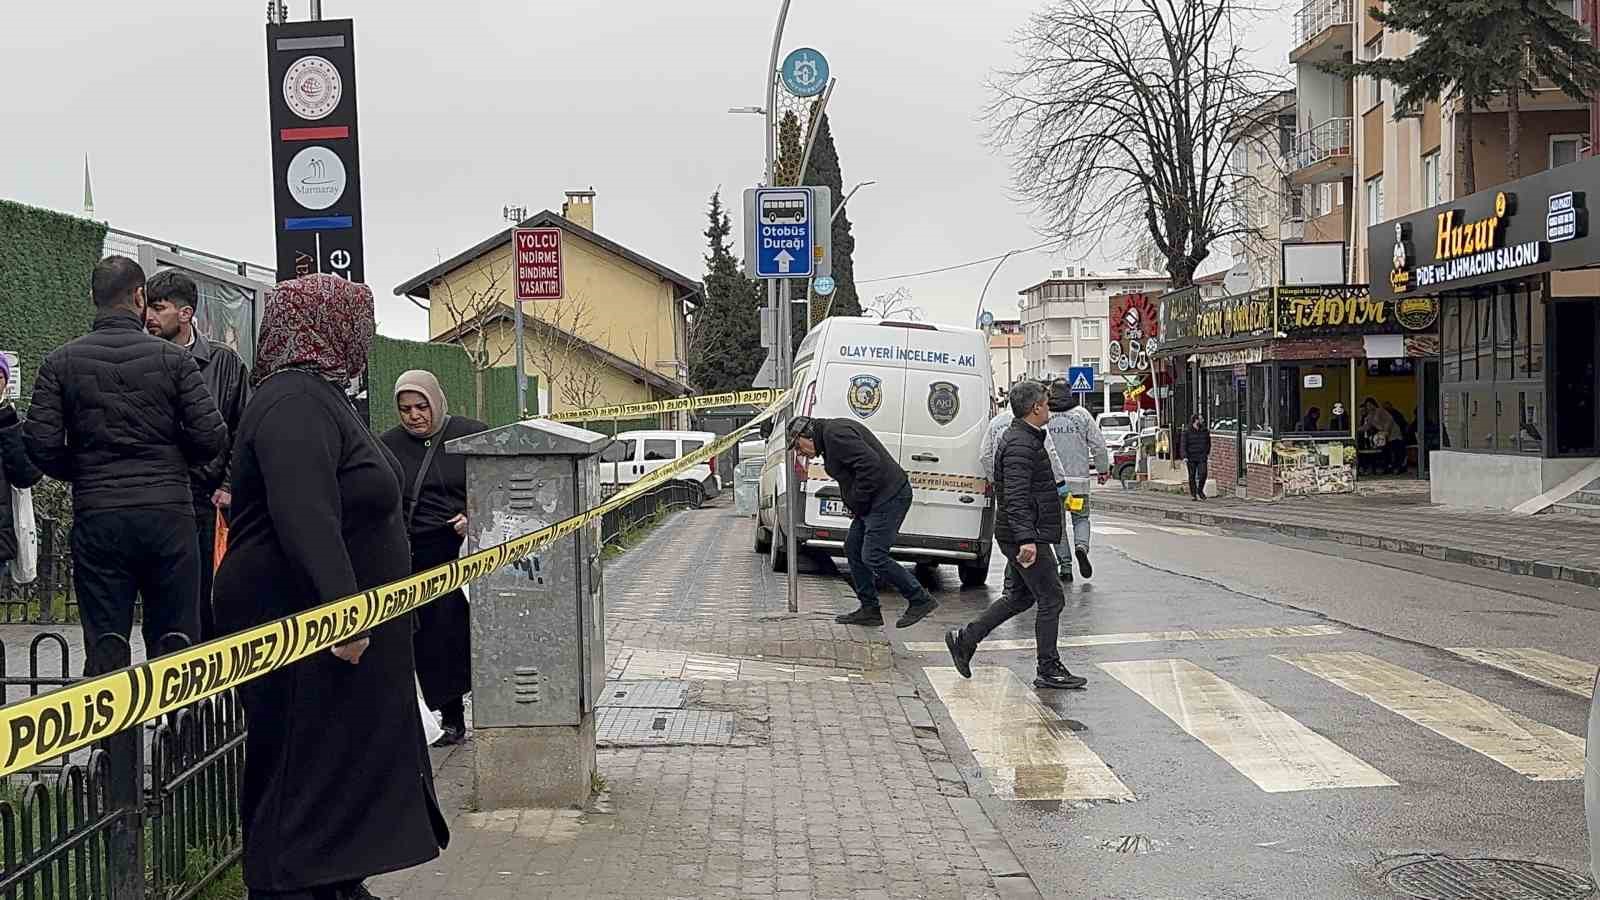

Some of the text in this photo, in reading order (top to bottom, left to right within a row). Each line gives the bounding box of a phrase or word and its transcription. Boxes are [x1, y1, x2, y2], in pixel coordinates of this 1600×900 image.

[295, 183, 340, 197] Marmaray
[762, 226, 806, 238] Otobüs
[1435, 208, 1499, 260] Huzur
[519, 234, 557, 249] YOLCU
[763, 237, 805, 251] Durağı
[519, 250, 558, 264] İNDİRME
[1435, 265, 1446, 281] ve
[1446, 249, 1495, 281] LAHMACUN
[1496, 240, 1540, 270] SALONU
[520, 265, 559, 280] BİNDİRME
[520, 280, 559, 295] YASAKTIR!
[1290, 296, 1387, 327] TADIM
[840, 345, 867, 357] OLAY
[870, 346, 893, 359] YERİ
[896, 346, 949, 364] İNCELEME
[958, 354, 976, 368] AKİ
[826, 502, 838, 513] 41
